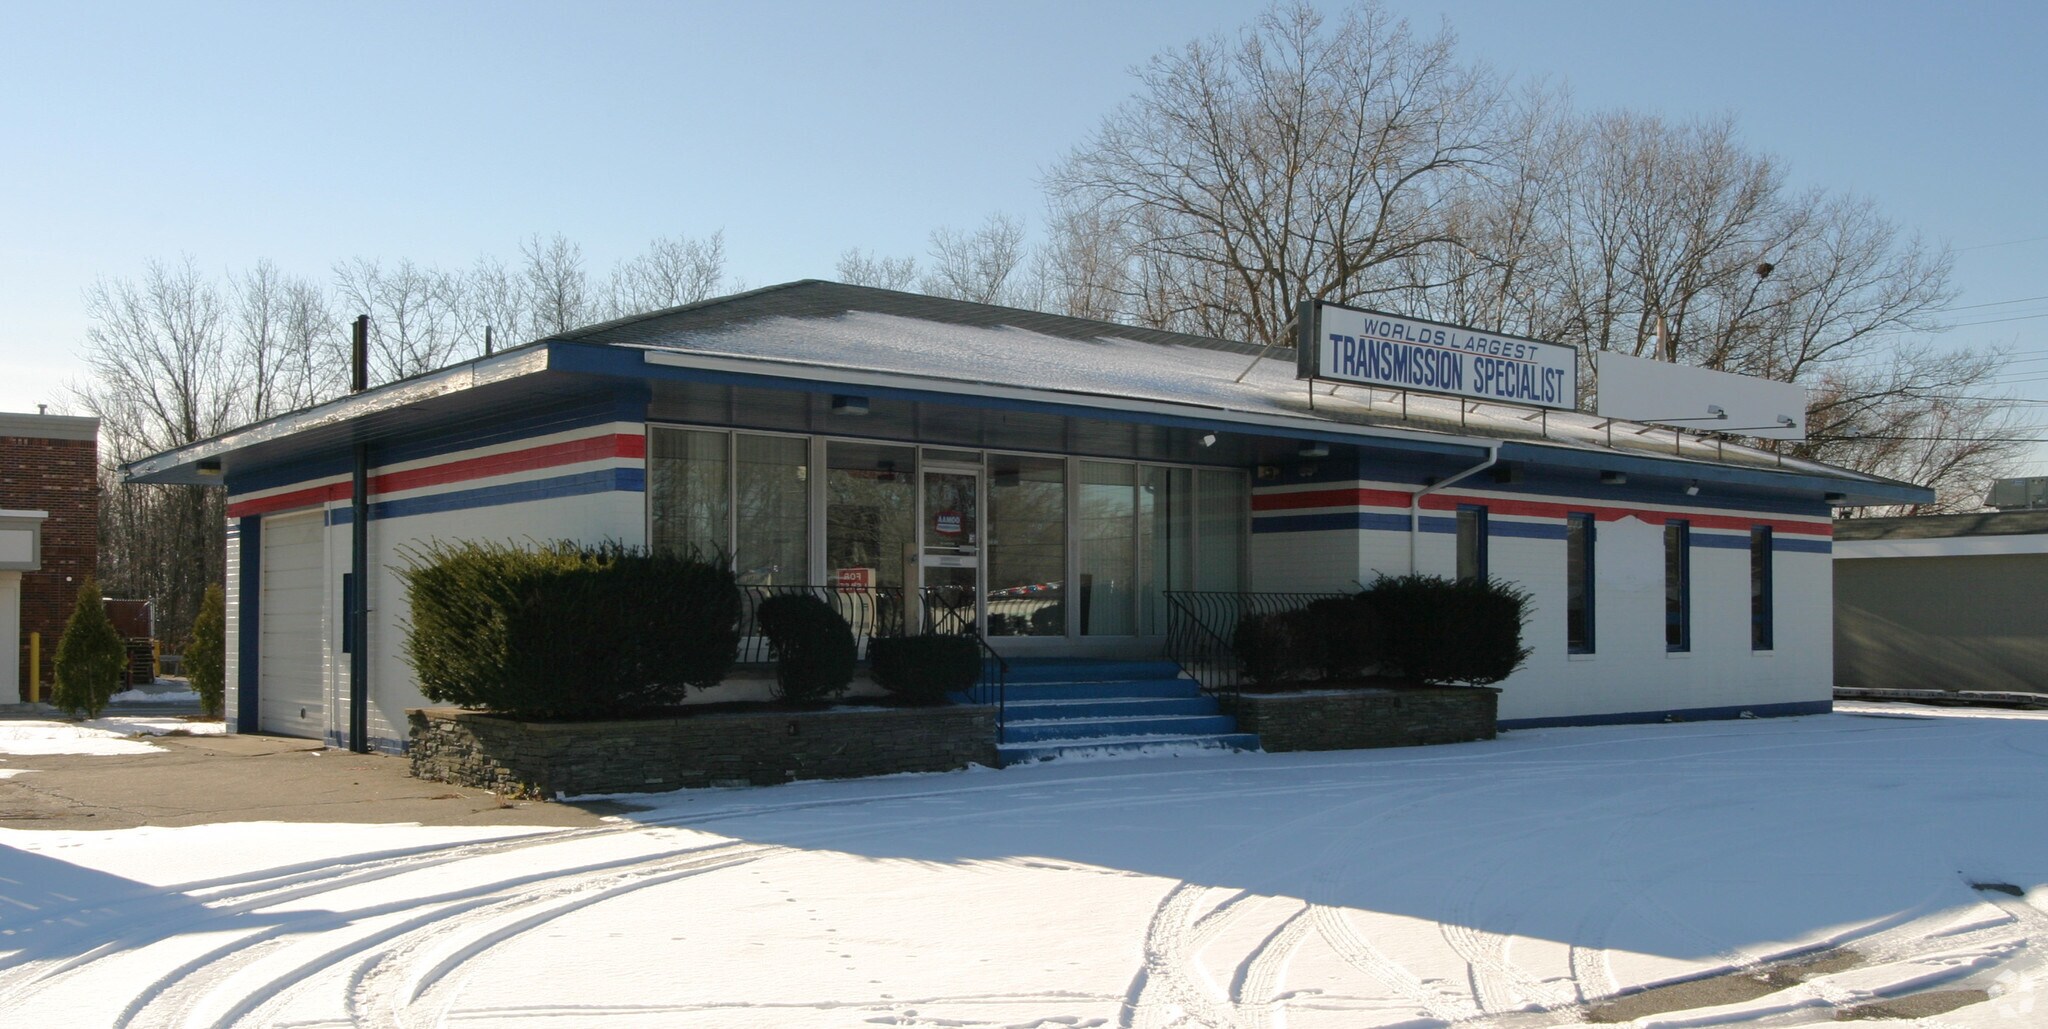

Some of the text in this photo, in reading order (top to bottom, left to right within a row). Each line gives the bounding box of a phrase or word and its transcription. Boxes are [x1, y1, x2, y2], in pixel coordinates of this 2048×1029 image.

[1364, 318, 1539, 361] WORLDS LARGEST
[1329, 333, 1565, 404] TRANSMISSION SPECIALIST
